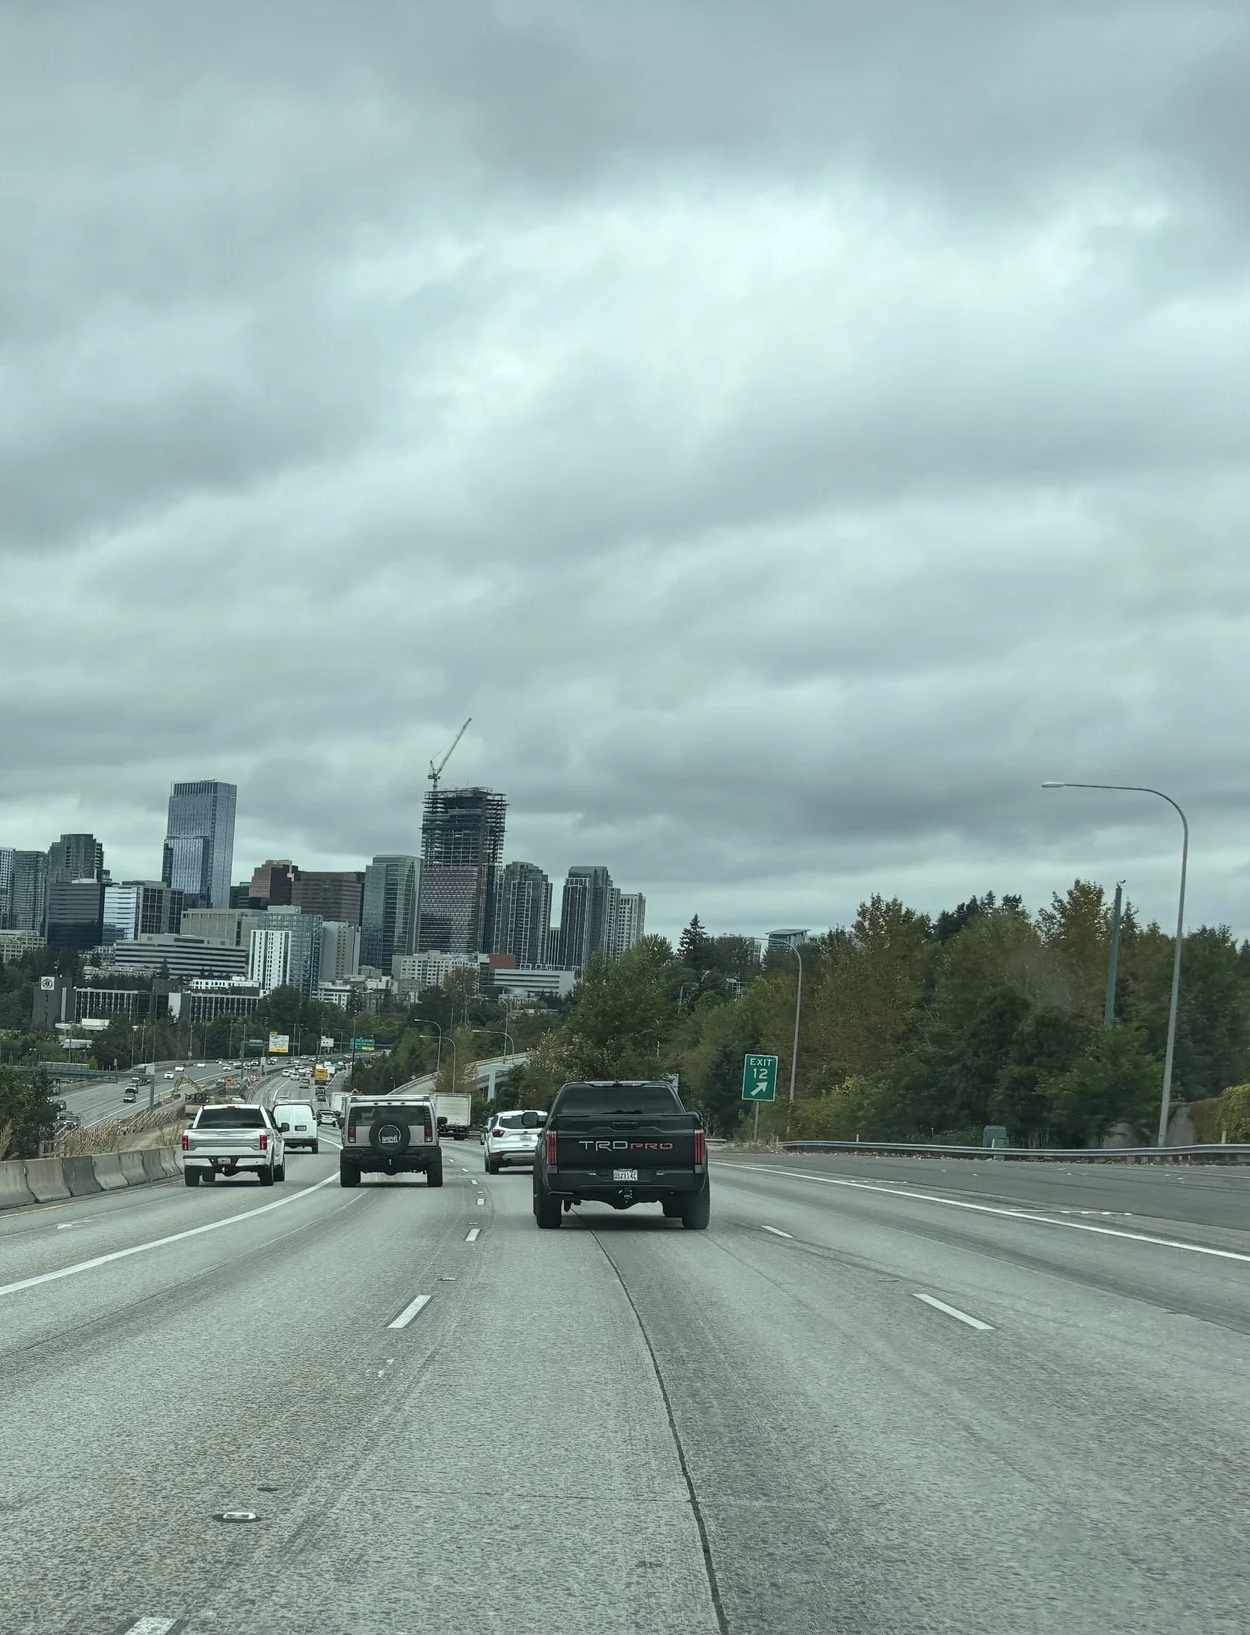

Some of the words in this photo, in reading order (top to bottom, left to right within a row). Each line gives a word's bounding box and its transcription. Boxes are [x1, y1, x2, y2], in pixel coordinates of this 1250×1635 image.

[750, 1058, 772, 1066] EXIT
[753, 1068, 768, 1079] 12
[579, 1141, 628, 1151] TRD
[630, 1142, 673, 1150] PRO
